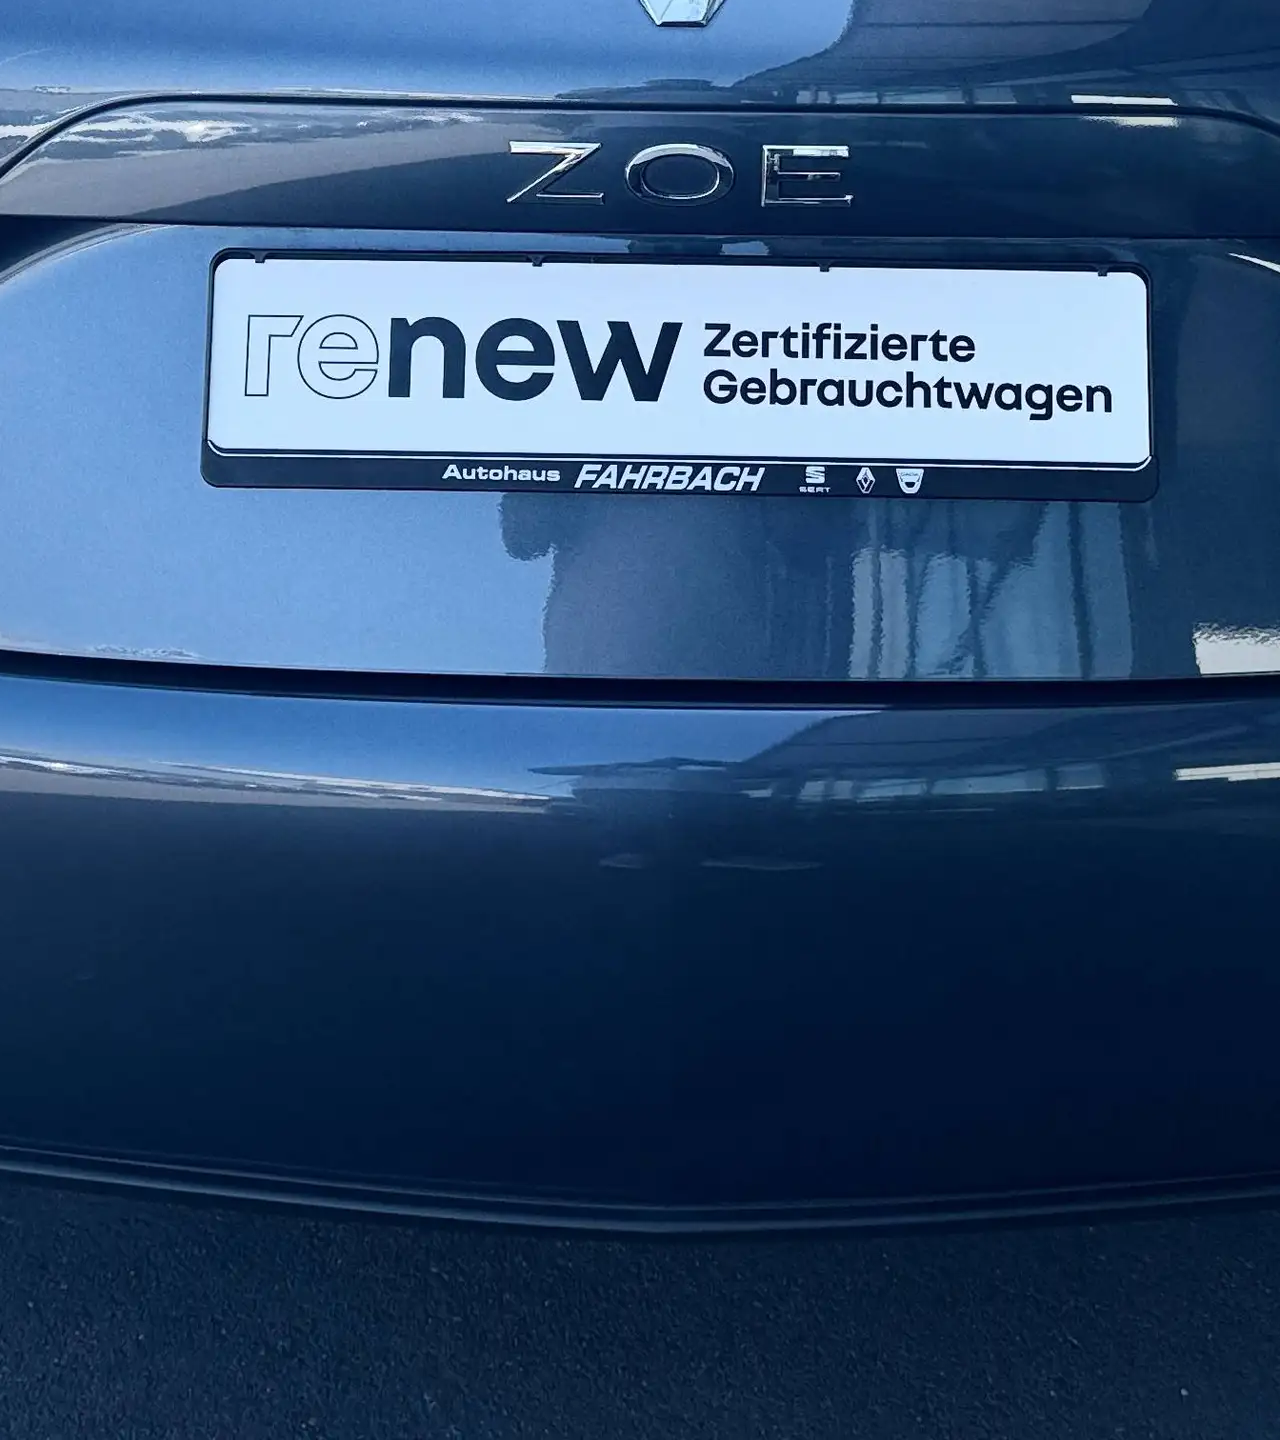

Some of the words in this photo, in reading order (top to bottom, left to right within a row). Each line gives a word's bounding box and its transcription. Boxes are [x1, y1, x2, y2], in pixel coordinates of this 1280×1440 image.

[505, 140, 854, 207] ZOE
[244, 313, 683, 402] renew
[703, 322, 976, 363] Zertifizierte
[703, 370, 1113, 421] Gebrauchtwagen
[442, 463, 561, 483] Autohaus
[574, 463, 766, 493] FAHRBACH
